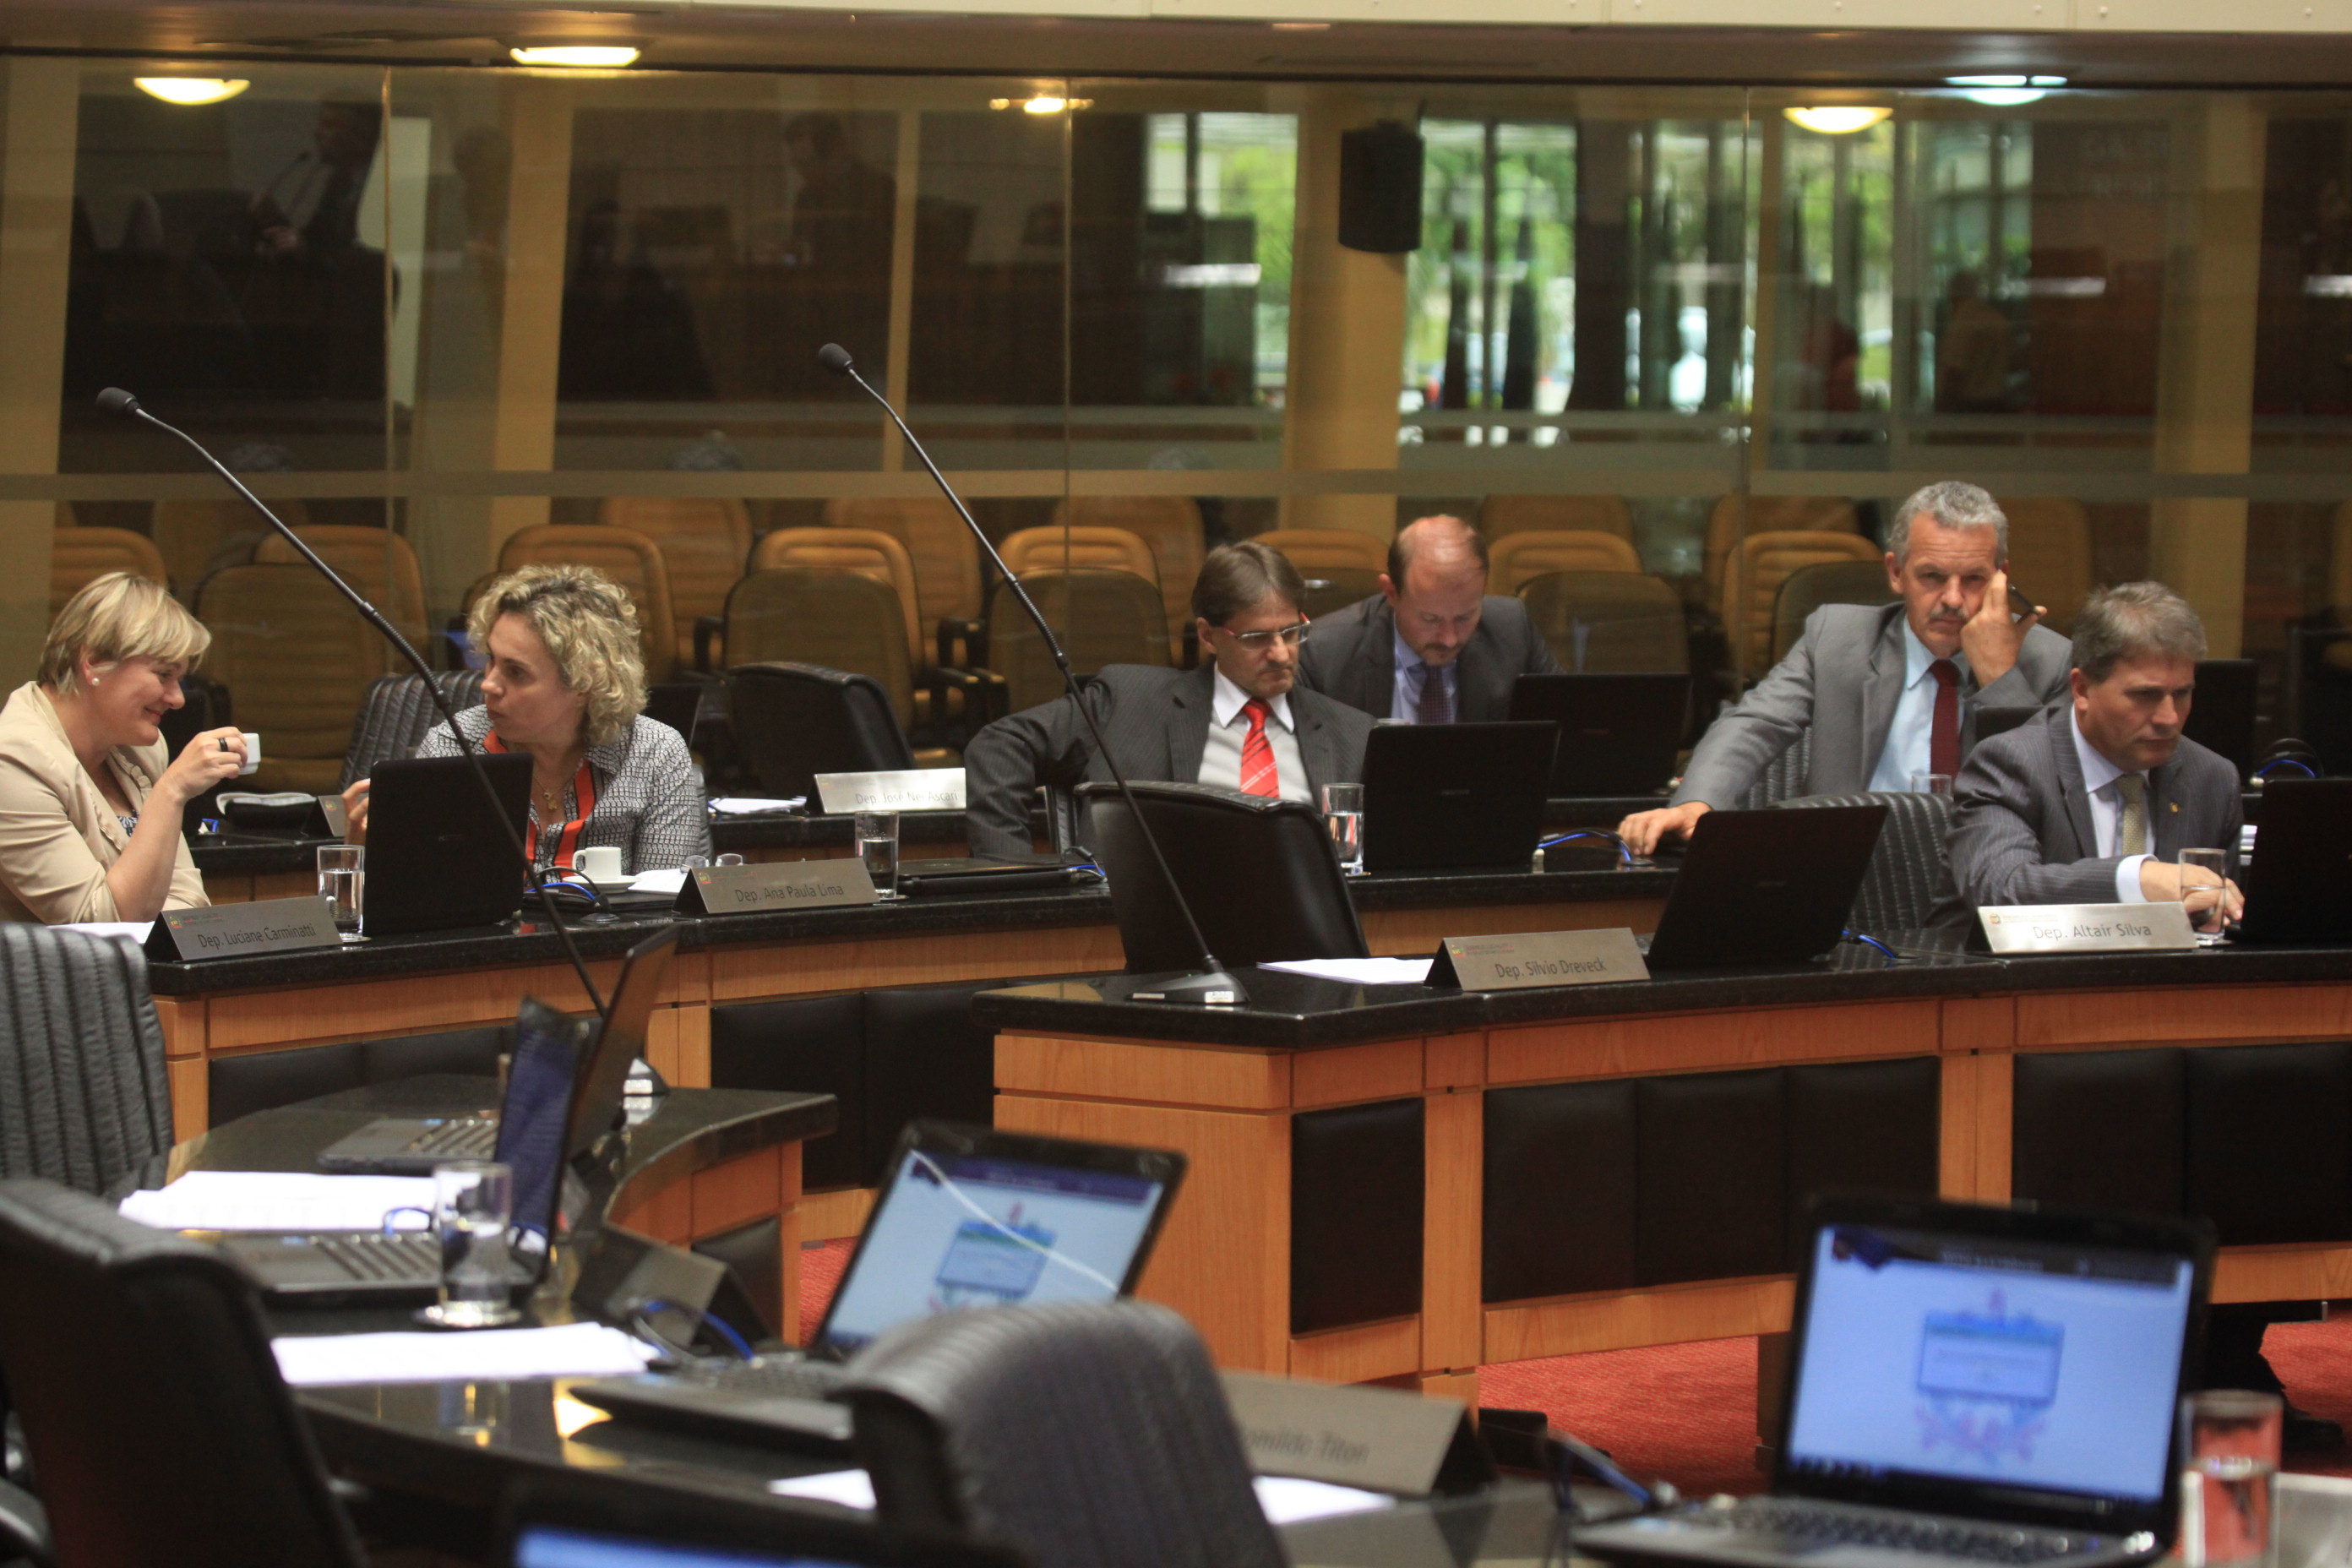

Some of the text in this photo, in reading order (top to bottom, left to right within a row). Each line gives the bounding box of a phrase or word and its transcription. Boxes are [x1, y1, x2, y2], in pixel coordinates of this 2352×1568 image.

[855, 792, 879, 805] Dep.
[735, 884, 844, 903] Dep. Ana Paula Lima
[197, 923, 316, 950] Dep. Luciane Carminatti
[2033, 923, 2153, 941] Dep. Altair Silva
[1494, 957, 1607, 981] Dep. Silvio Dreveck
